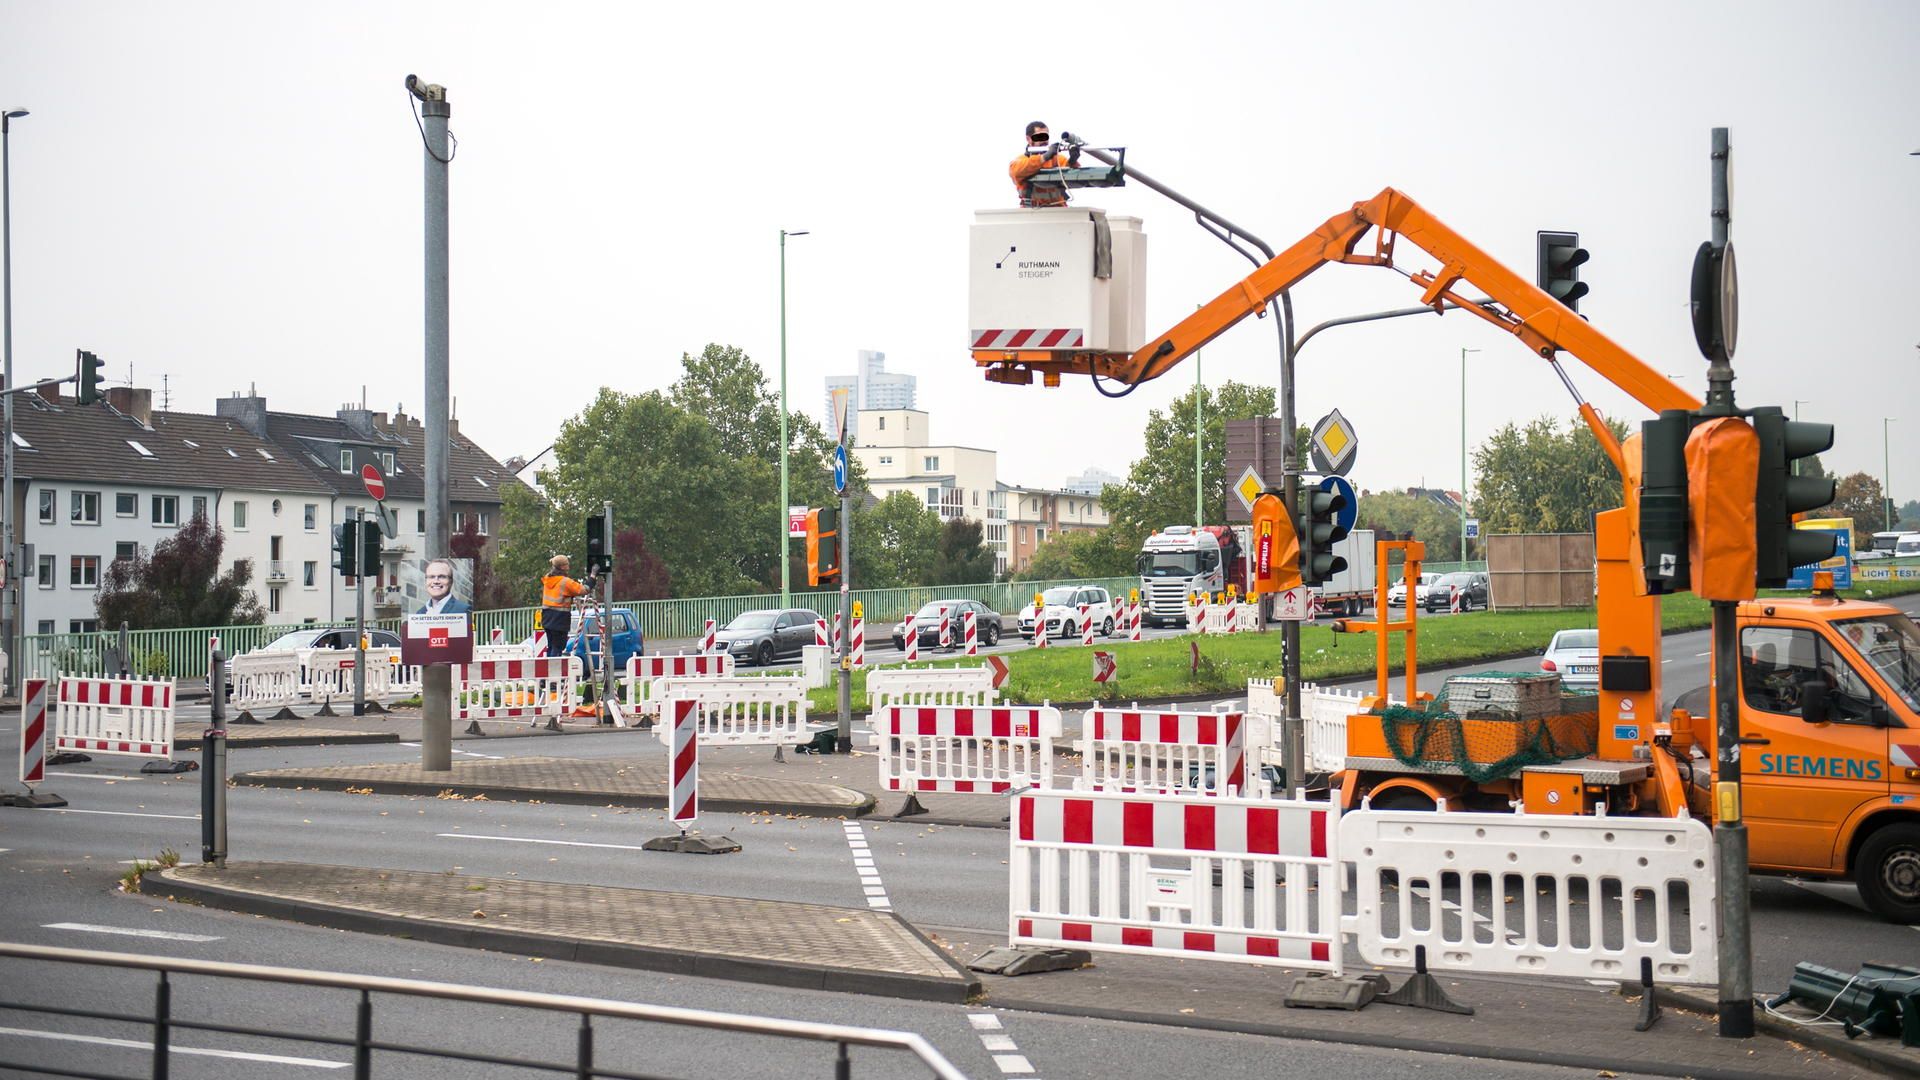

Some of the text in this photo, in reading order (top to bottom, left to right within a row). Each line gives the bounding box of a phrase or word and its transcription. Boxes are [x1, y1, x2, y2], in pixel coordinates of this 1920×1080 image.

[1018, 261, 1060, 269] RUTHMANN
[1261, 541, 1269, 574] ZEPPELIN
[1861, 569, 1889, 578] LICHT
[1759, 753, 1882, 780] SIEMENS
